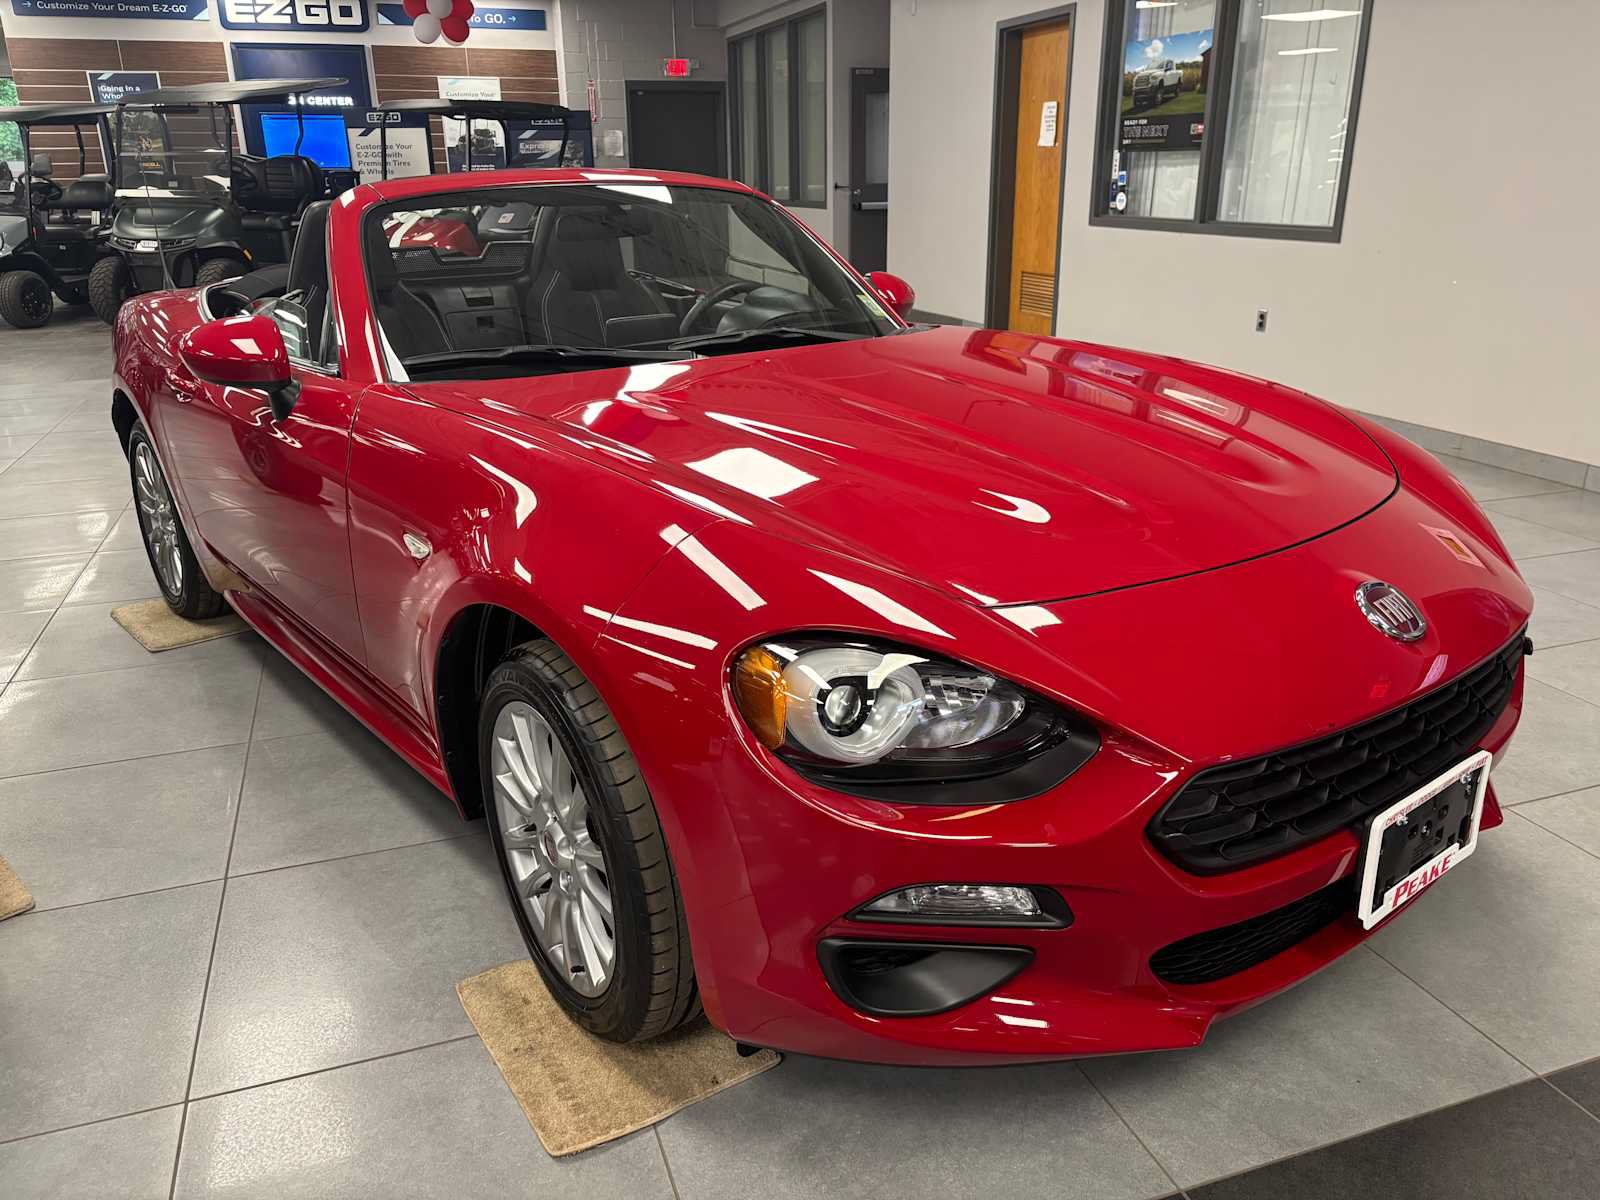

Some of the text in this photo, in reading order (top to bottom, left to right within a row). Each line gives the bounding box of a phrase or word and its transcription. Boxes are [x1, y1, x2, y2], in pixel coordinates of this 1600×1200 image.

[36, 0, 89, 10] Customize
[93, 2, 114, 11] Your
[118, 4, 150, 12] Dream
[484, 13, 507, 24] GO.
[100, 84, 124, 93] Going
[306, 95, 354, 106] CENTER
[1391, 854, 1452, 909] PEAKE
